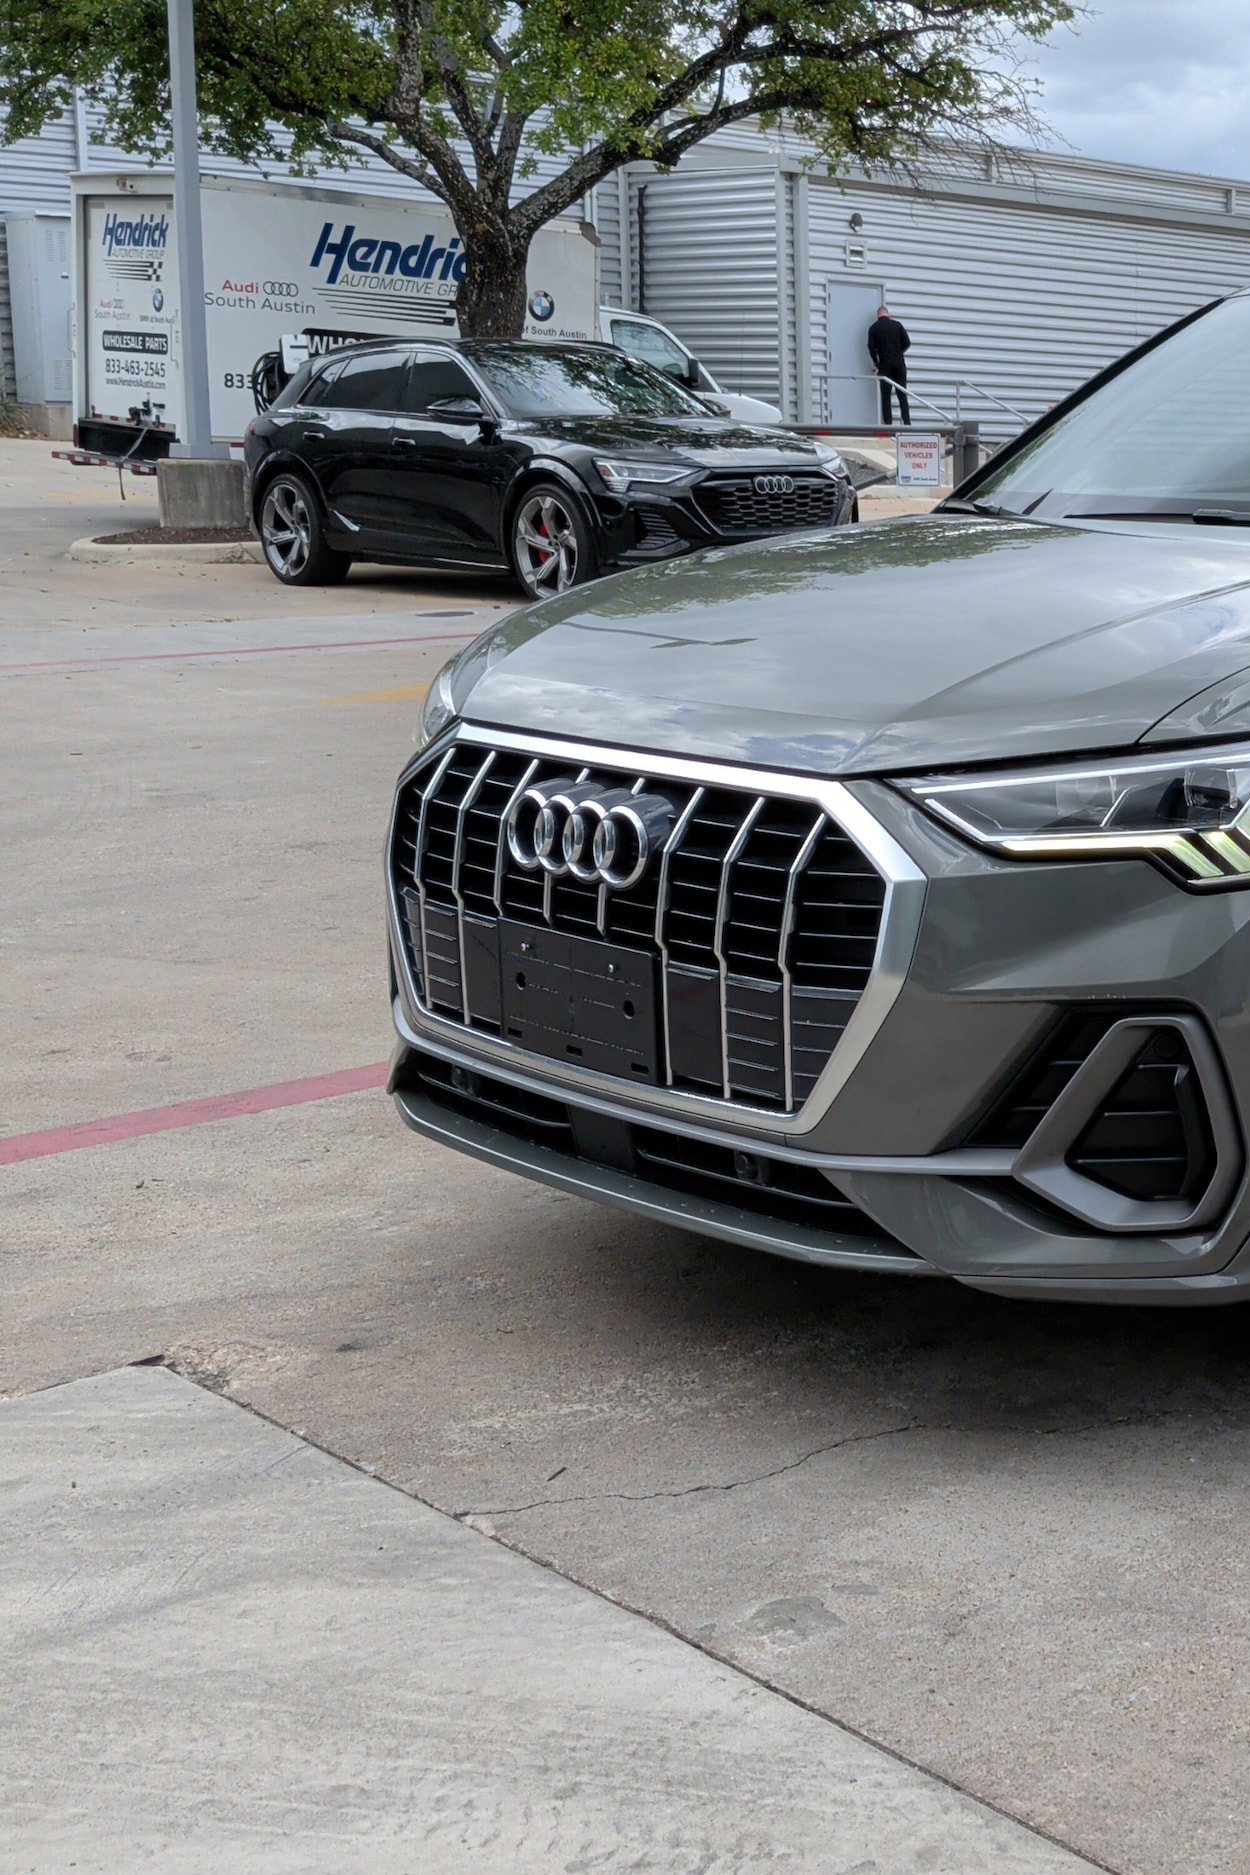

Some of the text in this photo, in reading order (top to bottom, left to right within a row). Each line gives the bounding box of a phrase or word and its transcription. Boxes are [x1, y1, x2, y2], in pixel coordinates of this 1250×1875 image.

[102, 213, 169, 257] Hendrick
[309, 222, 468, 285] Hendric
[222, 280, 259, 294] Audi
[338, 273, 434, 295] AUTOMOTIVE
[204, 292, 316, 315] South Austin
[104, 334, 167, 351] WHOLESALE PARTS
[531, 326, 557, 337] South
[559, 328, 587, 339] Austin
[105, 358, 166, 378] 833-463-2545
[900, 441, 938, 449] AUTHORIZED
